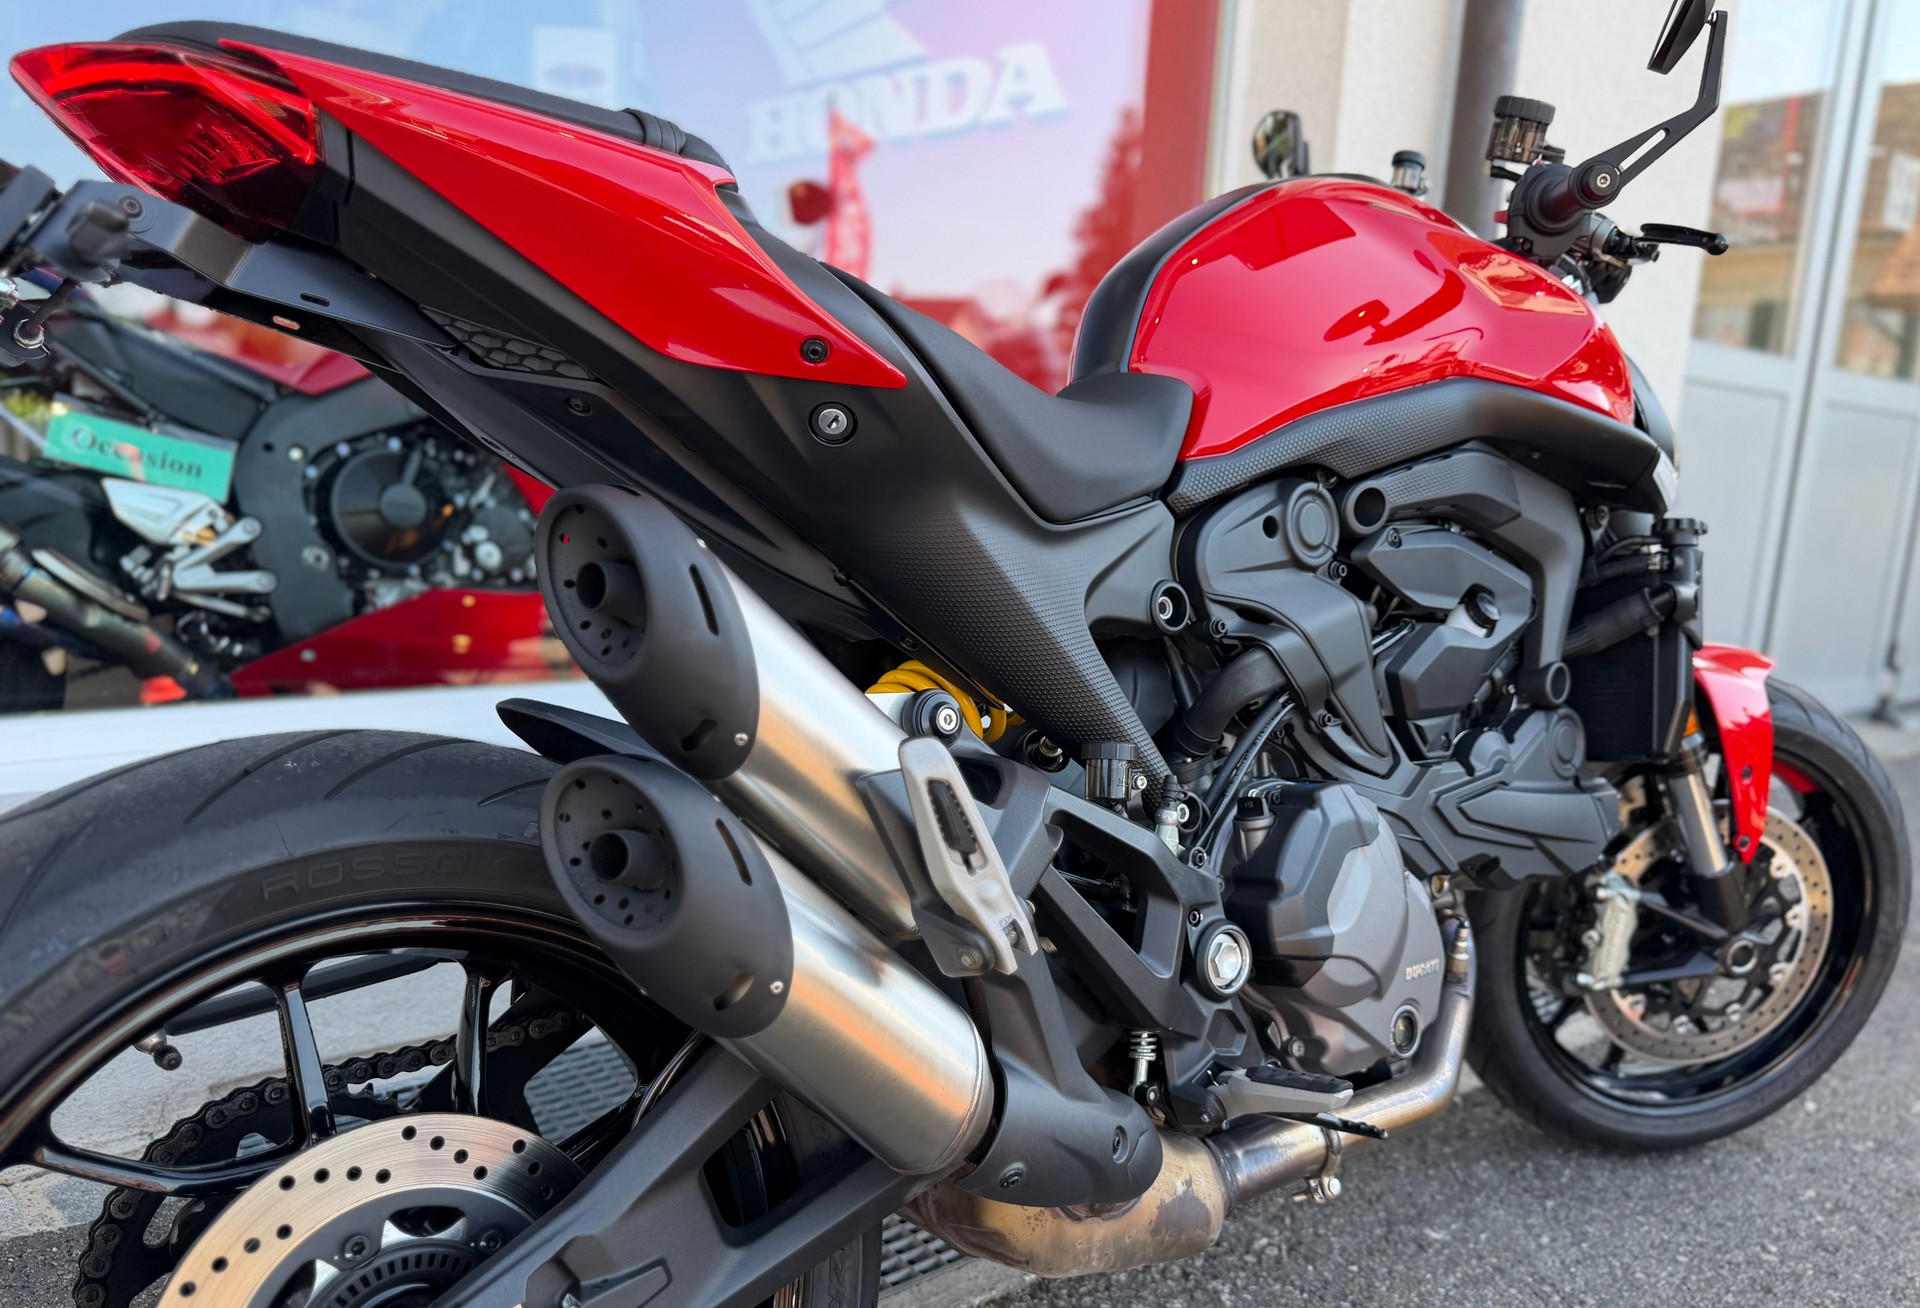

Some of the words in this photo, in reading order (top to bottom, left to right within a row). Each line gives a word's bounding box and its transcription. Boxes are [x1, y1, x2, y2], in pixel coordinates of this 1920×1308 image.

[744, 42, 1067, 163] HONDA
[72, 428, 202, 478] Occasion
[261, 852, 470, 901] ROSSO
[1405, 958, 1440, 980] DUCATI
